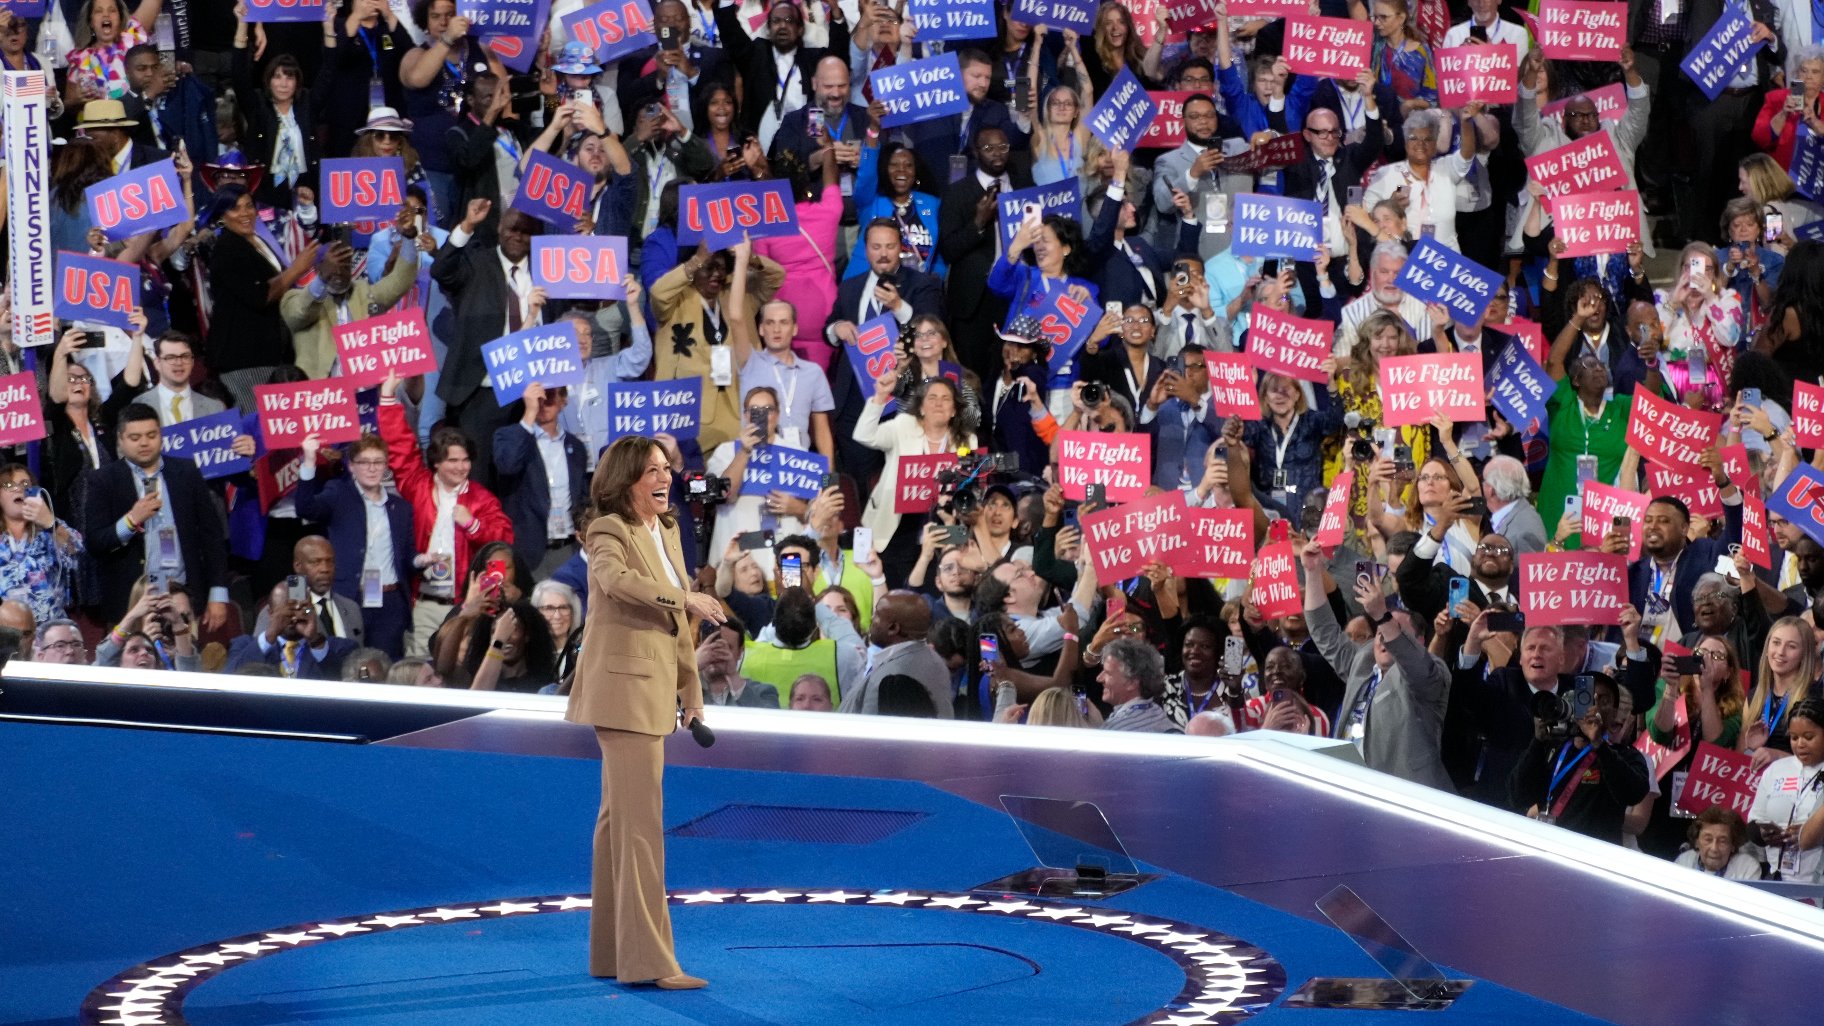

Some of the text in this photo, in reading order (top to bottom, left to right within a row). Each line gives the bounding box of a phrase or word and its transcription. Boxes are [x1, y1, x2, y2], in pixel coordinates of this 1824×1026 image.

[462, 9, 531, 26] We Win.
[914, 10, 989, 29] We Win.
[1020, 0, 1090, 24] We Win.
[1169, 5, 1196, 21] We
[1546, 8, 1621, 29] We Fight,
[572, 2, 649, 51] USA
[1291, 22, 1366, 48] We Fight,
[1544, 31, 1620, 50] We Win.
[1690, 20, 1744, 76] We Vote,
[1289, 44, 1365, 68] We Win.
[1440, 53, 1512, 73] We Fight,
[1702, 34, 1754, 89] We Win
[877, 66, 955, 95] We Vote,
[1443, 75, 1512, 94] We Win.
[885, 88, 960, 115] We Win.
[1092, 79, 1138, 134] We Vote,
[1157, 99, 1182, 118] Fig
[1110, 100, 1151, 150] We Win.
[1144, 122, 1160, 136] e
[1534, 143, 1610, 182] We Fight,
[329, 168, 402, 208] USA
[526, 162, 588, 218] USA
[1546, 166, 1618, 200] We Win.
[24, 104, 44, 306] TENNESSEE
[94, 174, 178, 228] USA
[706, 190, 790, 234] USA
[1038, 190, 1076, 210] Vote,
[1560, 200, 1634, 220] We Fight,
[1242, 203, 1318, 228] We Vote,
[1240, 227, 1318, 250] We Win.
[1562, 224, 1636, 245] We Win.
[540, 246, 620, 285] USA
[1418, 245, 1489, 296] We Vote,
[63, 266, 134, 314] USA
[1406, 265, 1436, 292] We
[1436, 282, 1476, 316] Win.
[341, 320, 421, 350] We Fight,
[1040, 293, 1089, 361] SA
[1256, 313, 1326, 349] We Fight,
[347, 346, 427, 376] We Win.
[489, 334, 572, 368] We Vote,
[1252, 336, 1323, 370] We Win.
[496, 358, 576, 392] We Win.
[1208, 360, 1249, 385] We Fight,
[1388, 364, 1476, 388] We Fight,
[1514, 360, 1543, 400] Vote,
[0, 386, 32, 407] ght,
[263, 394, 290, 412] We
[293, 387, 348, 409] Fight,
[615, 388, 696, 410] We Vote,
[1213, 386, 1254, 406] We Win.
[1390, 388, 1477, 411] We Win.
[1498, 378, 1528, 418] Win.
[1798, 391, 1820, 412] We
[269, 413, 352, 435] We Win.
[615, 413, 696, 432] We Win.
[1638, 395, 1710, 443] We Fight,
[1796, 416, 1822, 437] We
[189, 424, 238, 445] Vote,
[1632, 420, 1702, 466] We Win
[194, 448, 242, 470] Win.
[778, 452, 823, 474] Vote,
[1063, 440, 1142, 465] We Fight,
[742, 468, 772, 486] We
[778, 472, 822, 492] Win.
[904, 463, 930, 480] We
[1064, 467, 1143, 488] We Win.
[1655, 470, 1684, 488] We
[902, 484, 932, 502] We
[1586, 490, 1642, 523] We Fight,
[1091, 504, 1182, 544] We Fight,
[1196, 518, 1247, 539] Fight,
[1584, 514, 1599, 536] We
[1098, 534, 1188, 570] We Win.
[1204, 545, 1248, 566] Win.
[1263, 554, 1292, 580] Fight,
[1528, 562, 1622, 586] We Fight,
[1252, 582, 1296, 606] We Win.
[1528, 589, 1624, 611] We Win.
[1701, 754, 1732, 778] We
[1731, 765, 1761, 793] Fig
[1692, 780, 1726, 805] We
